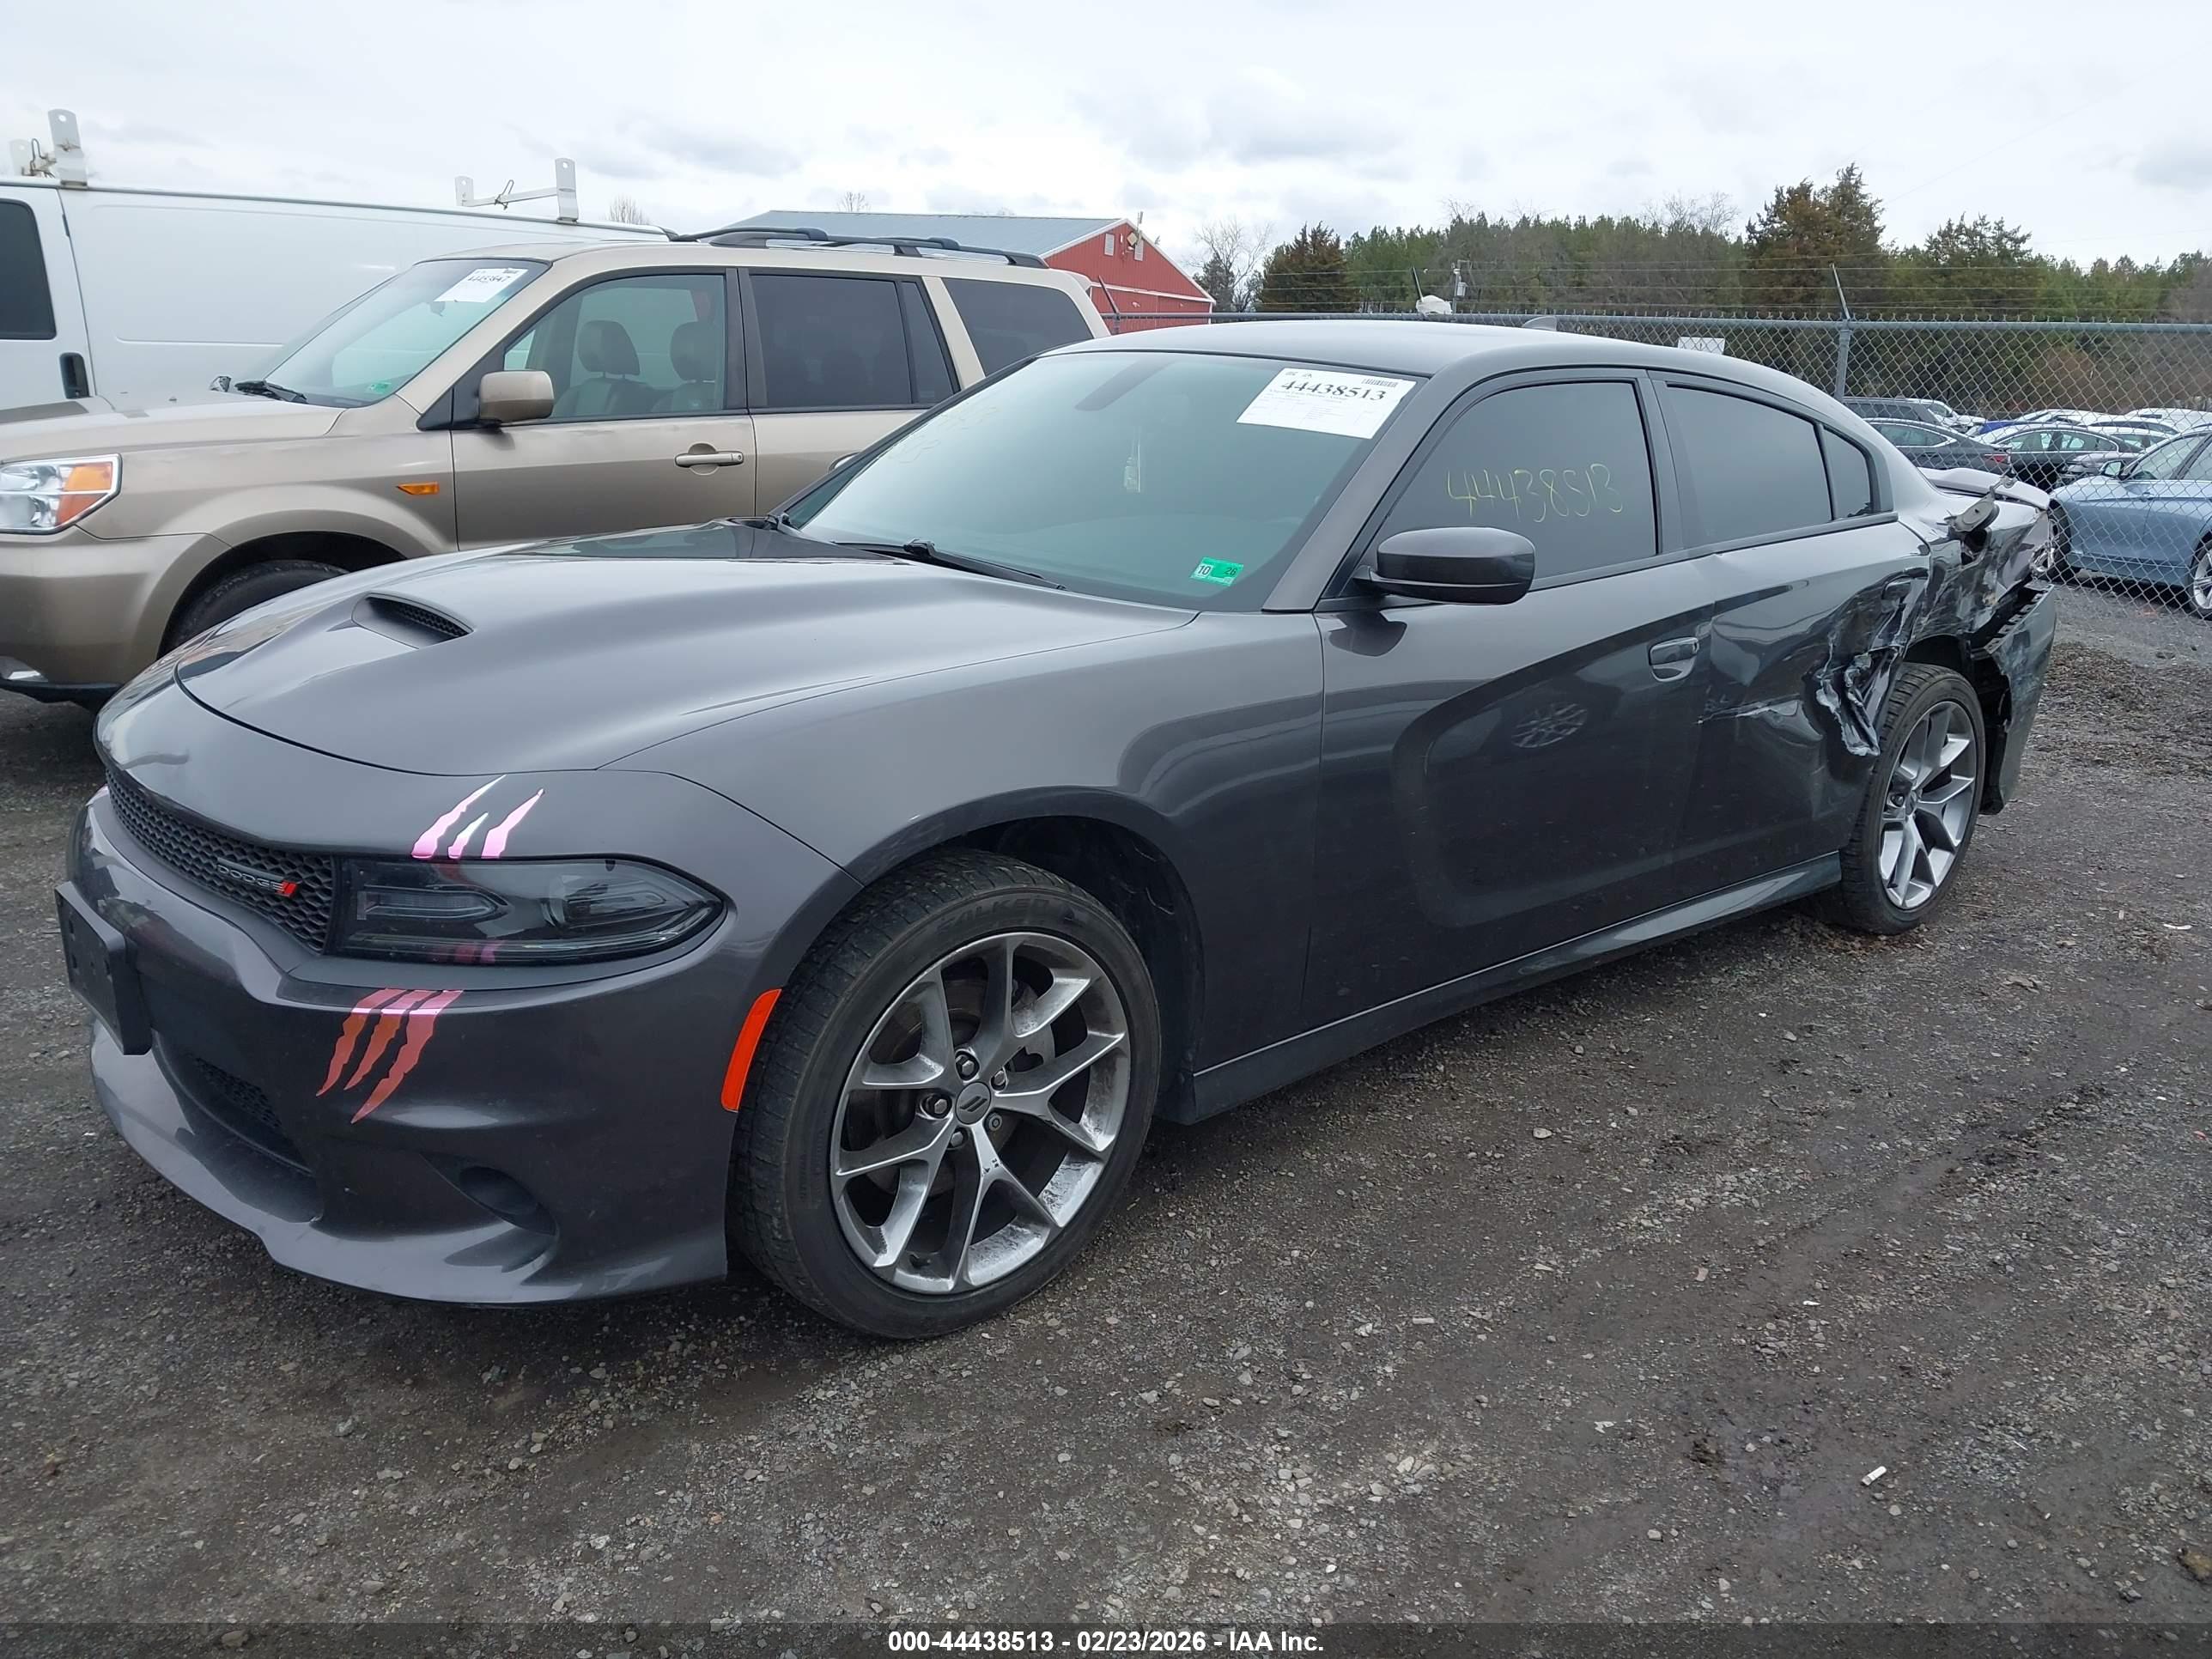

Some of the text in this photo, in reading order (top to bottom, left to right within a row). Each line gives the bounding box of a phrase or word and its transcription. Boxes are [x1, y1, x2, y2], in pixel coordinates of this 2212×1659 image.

[1281, 380, 1386, 401] 44438513
[1446, 464, 1623, 522] 44438513
[1198, 565, 1237, 576] 10 26
[216, 864, 285, 891] DODGE
